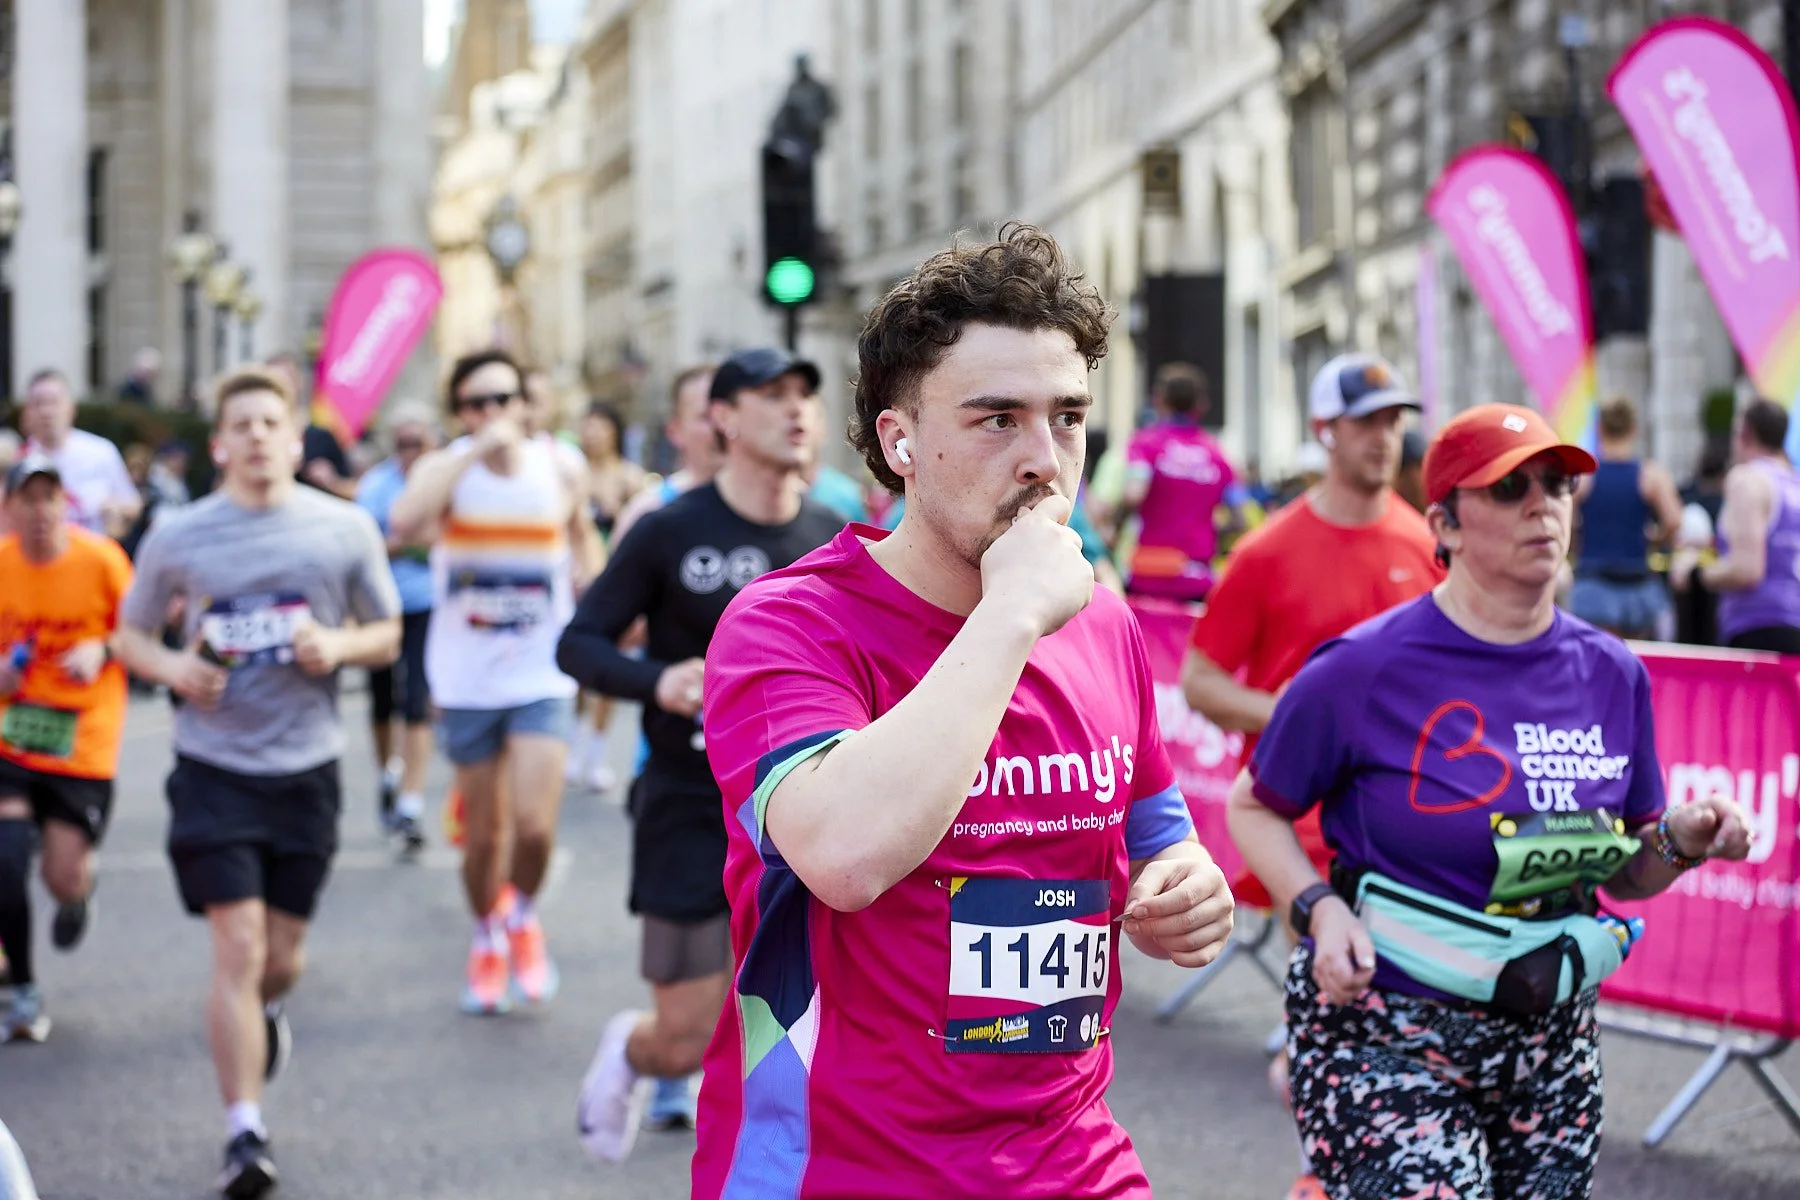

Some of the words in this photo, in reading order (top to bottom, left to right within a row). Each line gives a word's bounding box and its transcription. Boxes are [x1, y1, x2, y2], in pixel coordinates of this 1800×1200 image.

[1513, 722, 1606, 757] Blood
[967, 735, 1135, 804] ommy's
[1520, 753, 1630, 781] cancer
[1524, 779, 1580, 812] UK
[953, 820, 1034, 839] pregnancy
[1037, 815, 1068, 832] and
[1071, 812, 1106, 831] baby
[1034, 889, 1076, 908] JOSH
[968, 932, 1107, 989] 11415
[963, 1024, 995, 1041] LONDON
